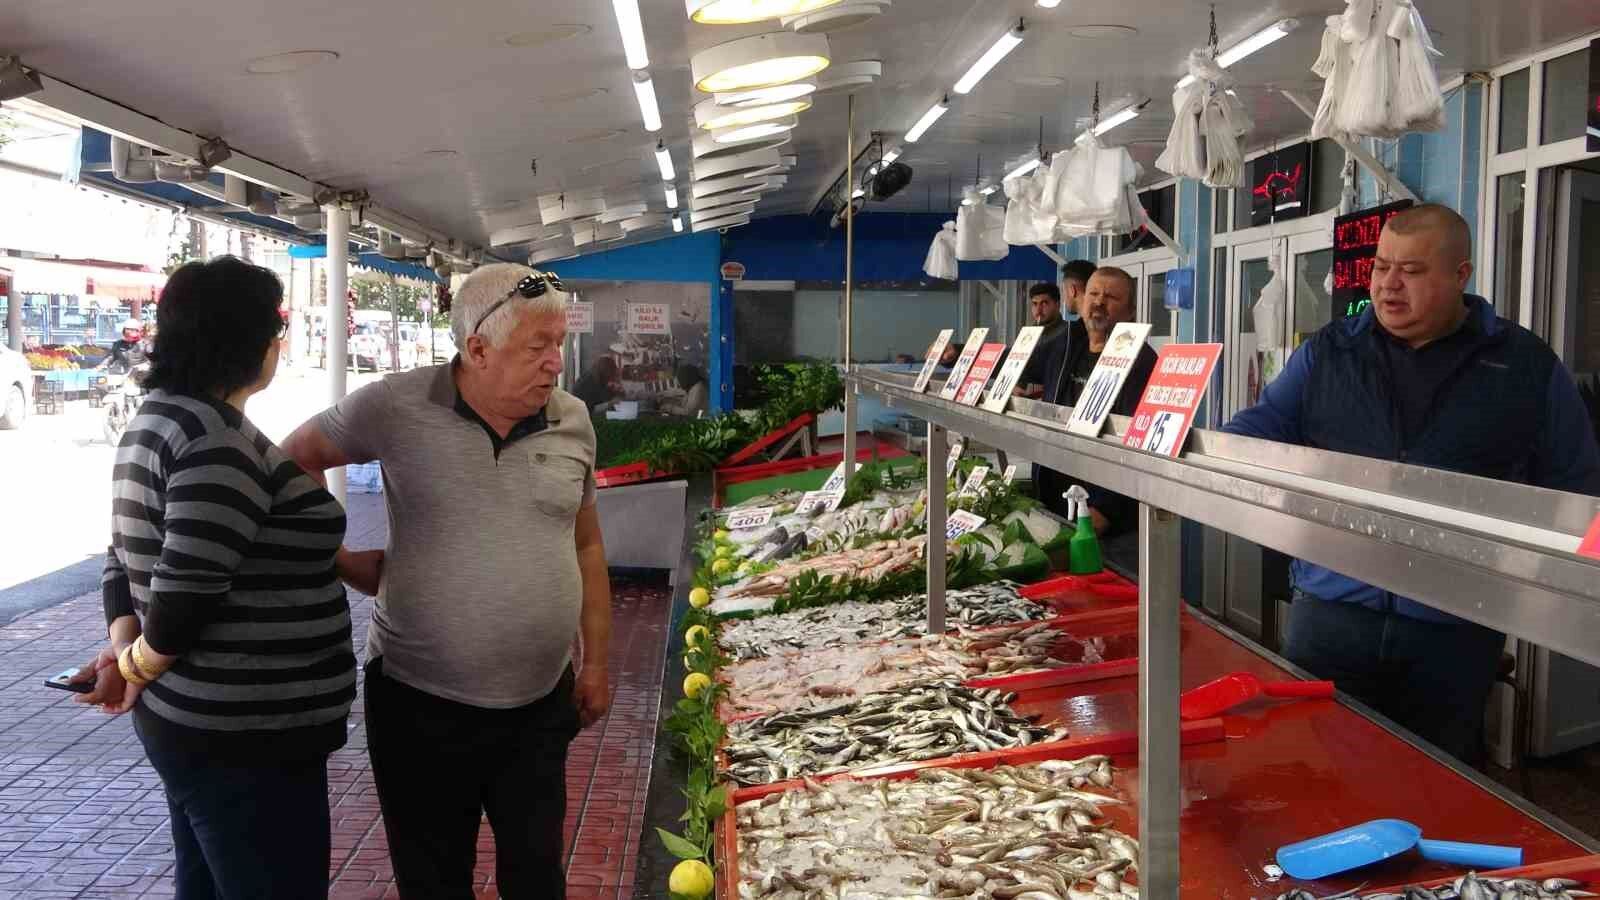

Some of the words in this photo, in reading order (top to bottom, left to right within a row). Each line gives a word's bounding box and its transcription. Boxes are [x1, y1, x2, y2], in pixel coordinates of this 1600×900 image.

[1098, 354, 1131, 370] MEZGİT
[1079, 371, 1121, 424] 100
[1147, 413, 1172, 452] 15
[734, 516, 765, 527] 400
